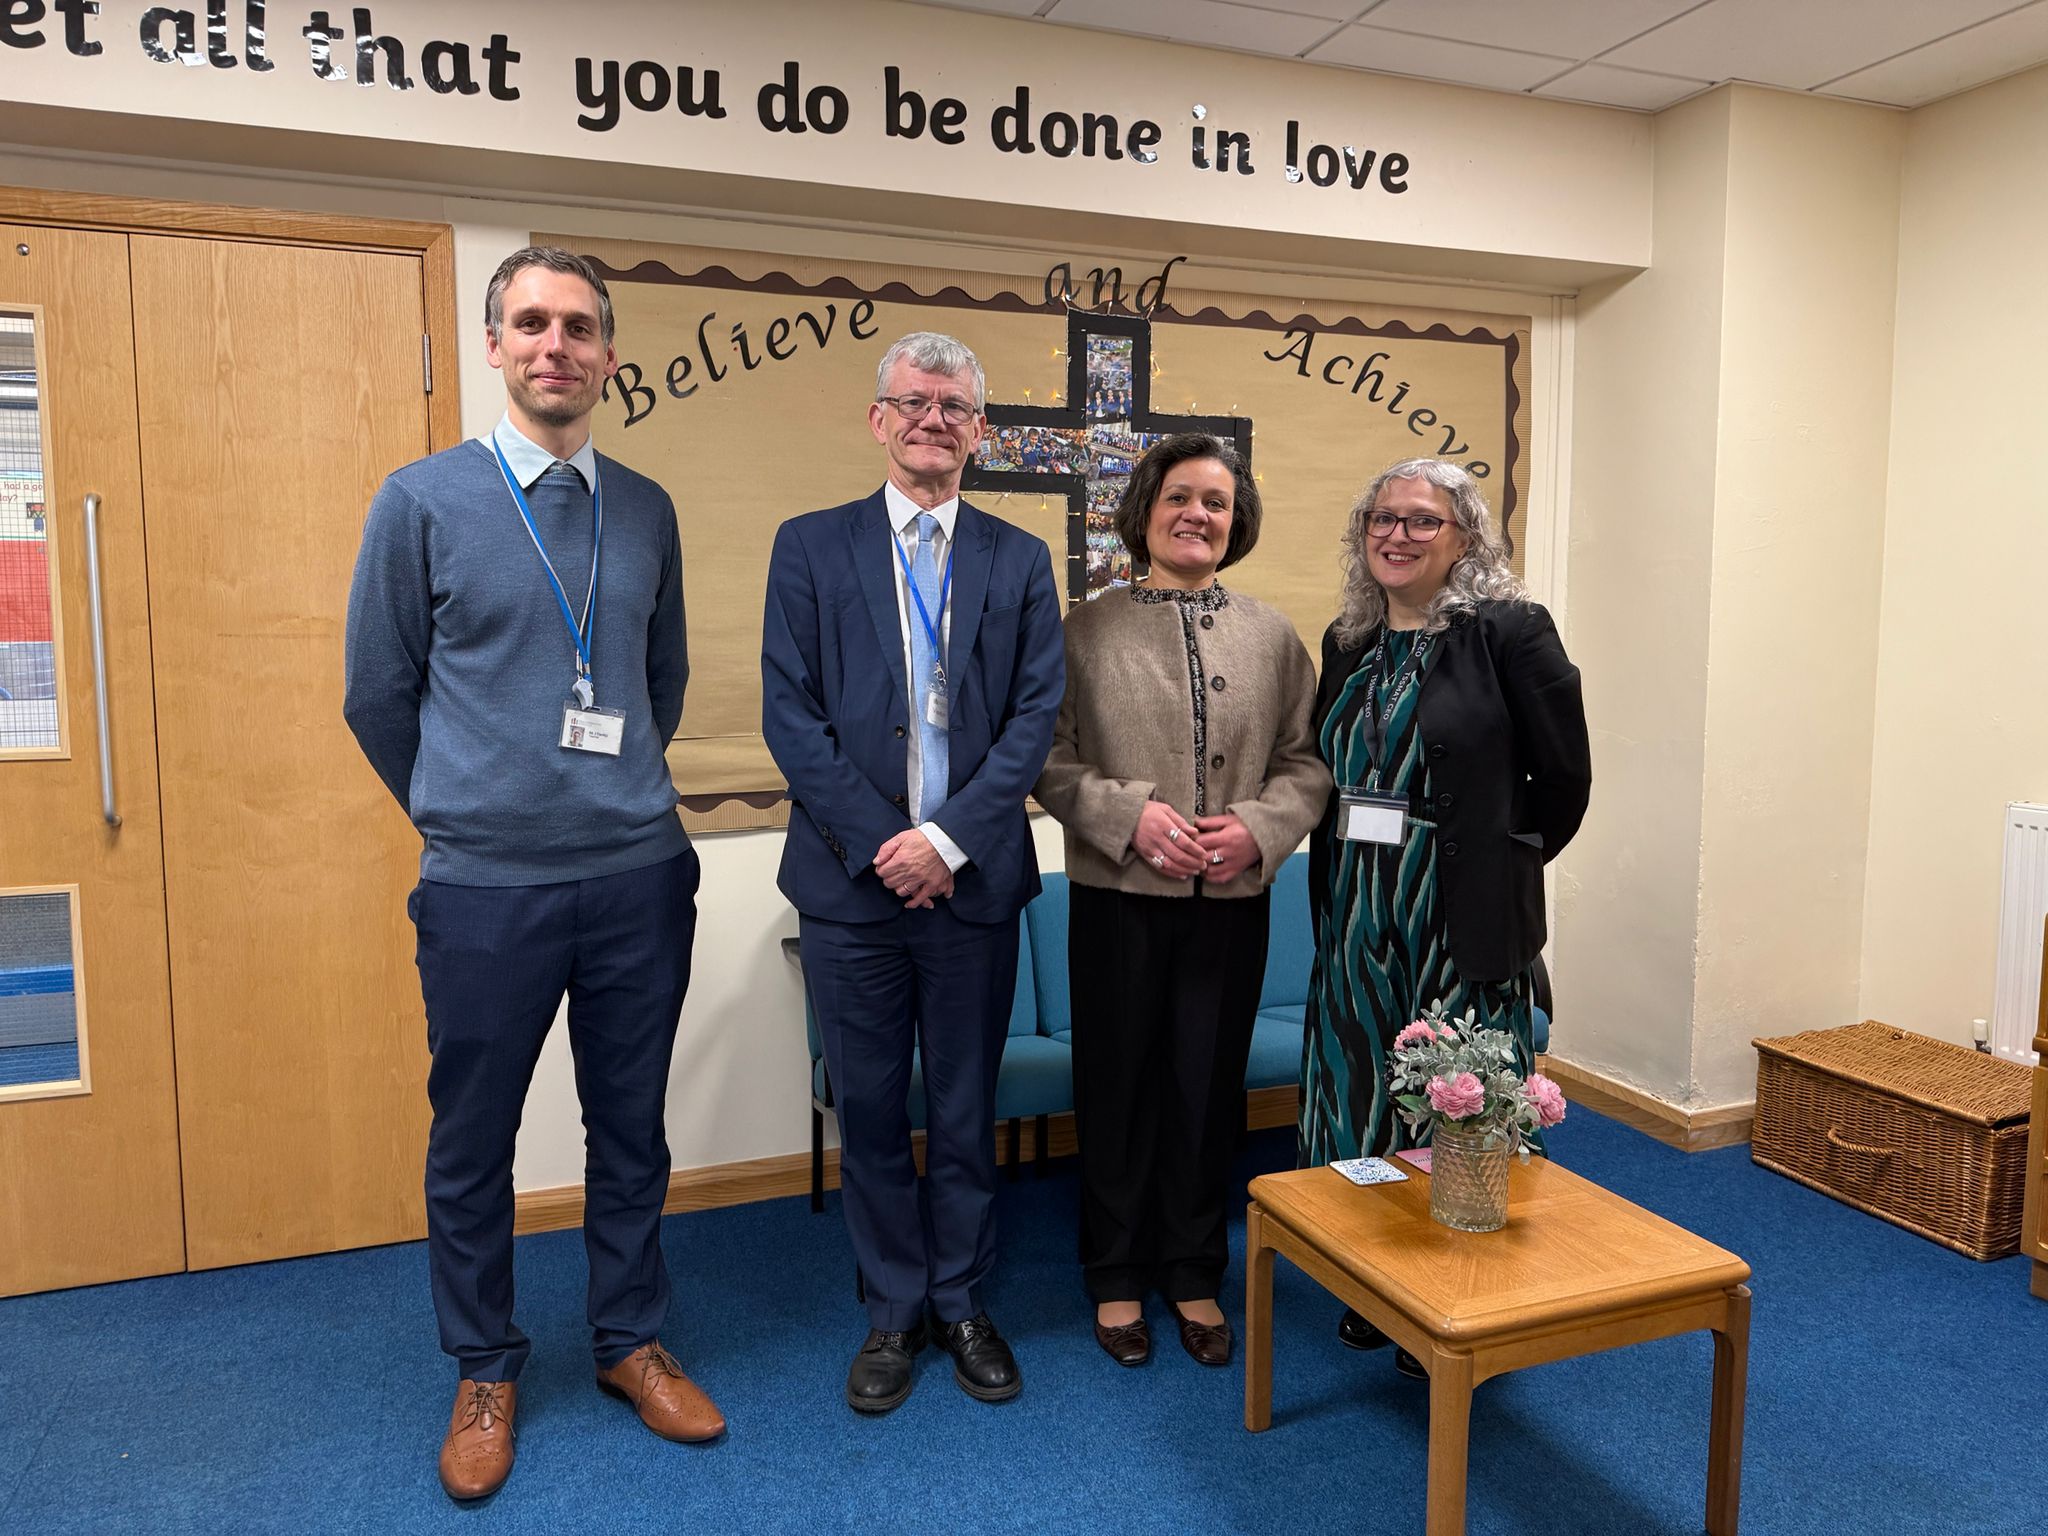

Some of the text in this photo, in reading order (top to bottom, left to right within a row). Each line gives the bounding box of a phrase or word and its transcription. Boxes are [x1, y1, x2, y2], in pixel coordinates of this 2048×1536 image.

[139, 0, 275, 72] all
[302, 8, 521, 101] that
[575, 57, 727, 132] you
[757, 61, 849, 134] do
[884, 66, 968, 145] be
[991, 86, 1162, 165] done
[1191, 103, 1256, 176] in
[1285, 120, 1410, 194] love
[602, 299, 879, 429] Believe
[1044, 256, 1188, 314] and
[4, 481, 21, 490] had
[1415, 641, 1427, 657] CEO
[1383, 703, 1394, 720] CEO
